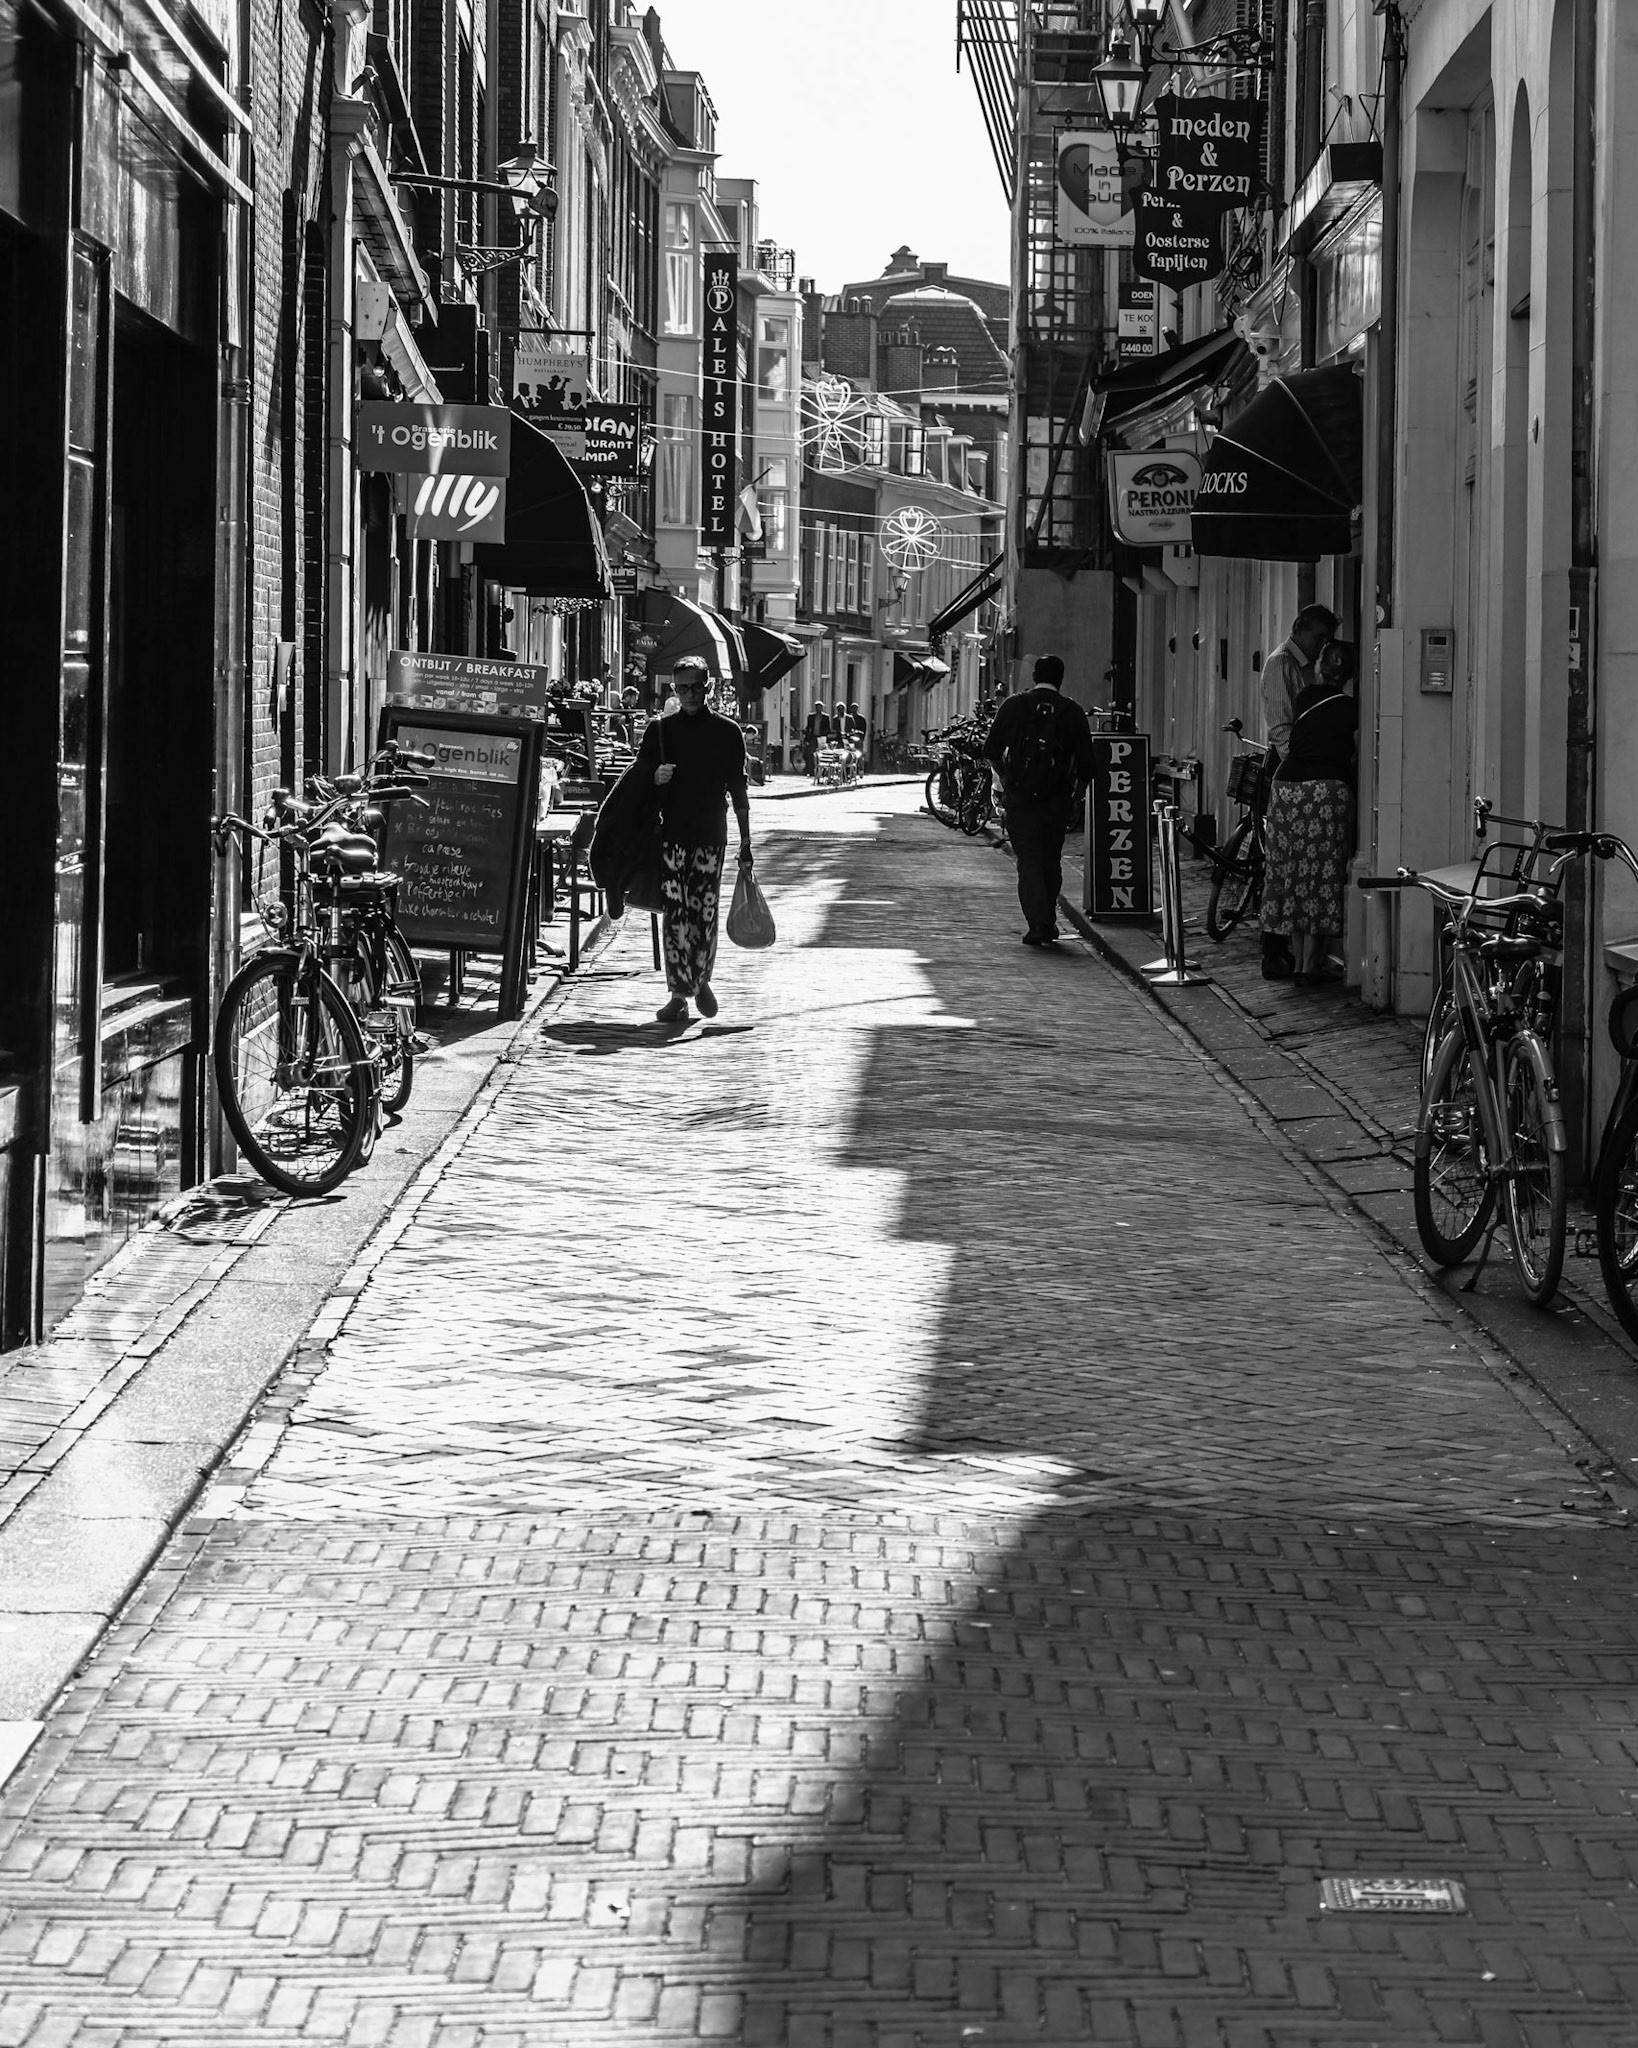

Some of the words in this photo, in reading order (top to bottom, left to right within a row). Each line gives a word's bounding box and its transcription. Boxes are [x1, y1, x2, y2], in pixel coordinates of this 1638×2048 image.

[1170, 112, 1250, 143] meden
[1200, 142, 1218, 167] &
[1167, 166, 1250, 197] Perzen
[1172, 212, 1183, 228] &
[1145, 232, 1210, 248] Oosterse
[1147, 252, 1208, 271] Tapijten
[1124, 314, 1135, 323] TE
[518, 357, 583, 369] HUMPHREY'S
[371, 425, 385, 445] 't
[391, 426, 498, 451] Ogenblik
[412, 425, 456, 434] Brasserie
[711, 431, 727, 532] HOTEL
[414, 475, 500, 532] illy
[1127, 490, 1195, 508] PERONI
[1128, 508, 1159, 517] NASTRO
[400, 657, 451, 672] ONTBIJT
[466, 663, 537, 680] BREAKFAST
[422, 743, 510, 766] Ogenblik
[1108, 742, 1134, 908] PERZEN
